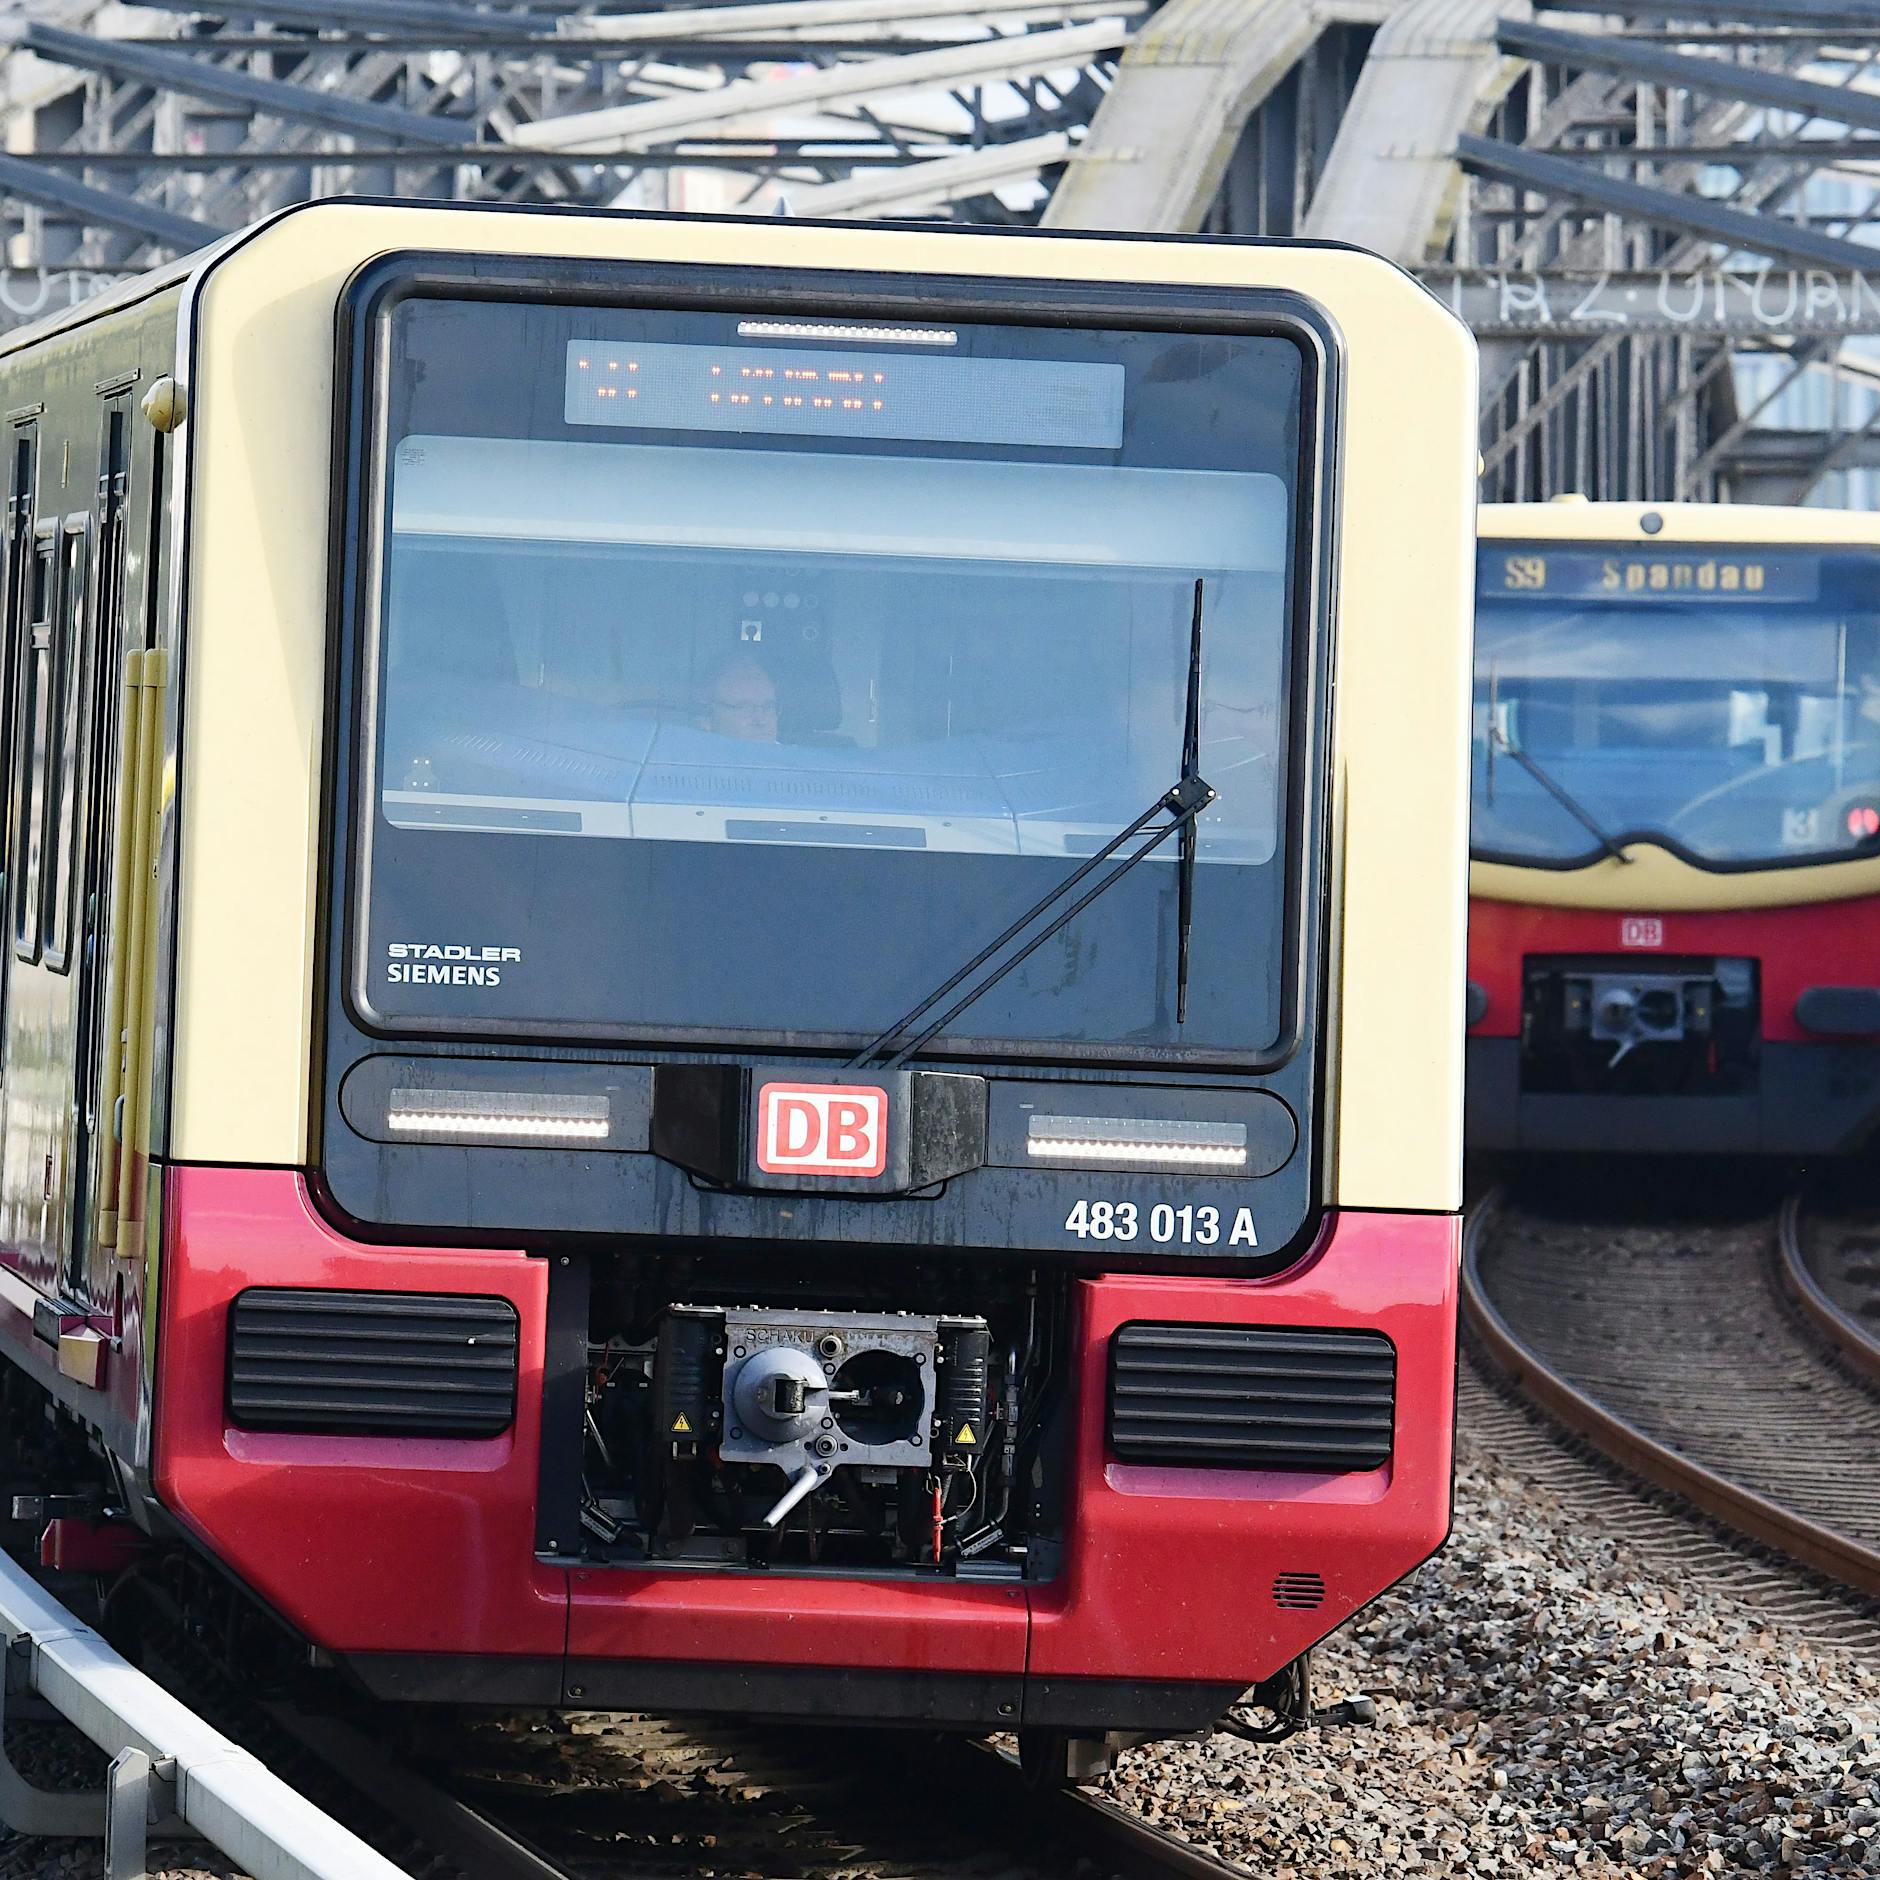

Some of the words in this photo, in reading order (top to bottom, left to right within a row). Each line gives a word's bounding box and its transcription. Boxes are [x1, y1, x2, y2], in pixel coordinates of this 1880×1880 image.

[1505, 556, 1546, 589] S9
[1602, 559, 1765, 591] Spandau
[388, 943, 522, 963] STADLER
[387, 963, 501, 987] SIEMENS
[775, 1098, 871, 1161] DB
[1065, 1199, 1139, 1241] 483
[1150, 1203, 1221, 1245] 013
[1228, 1207, 1259, 1247] A
